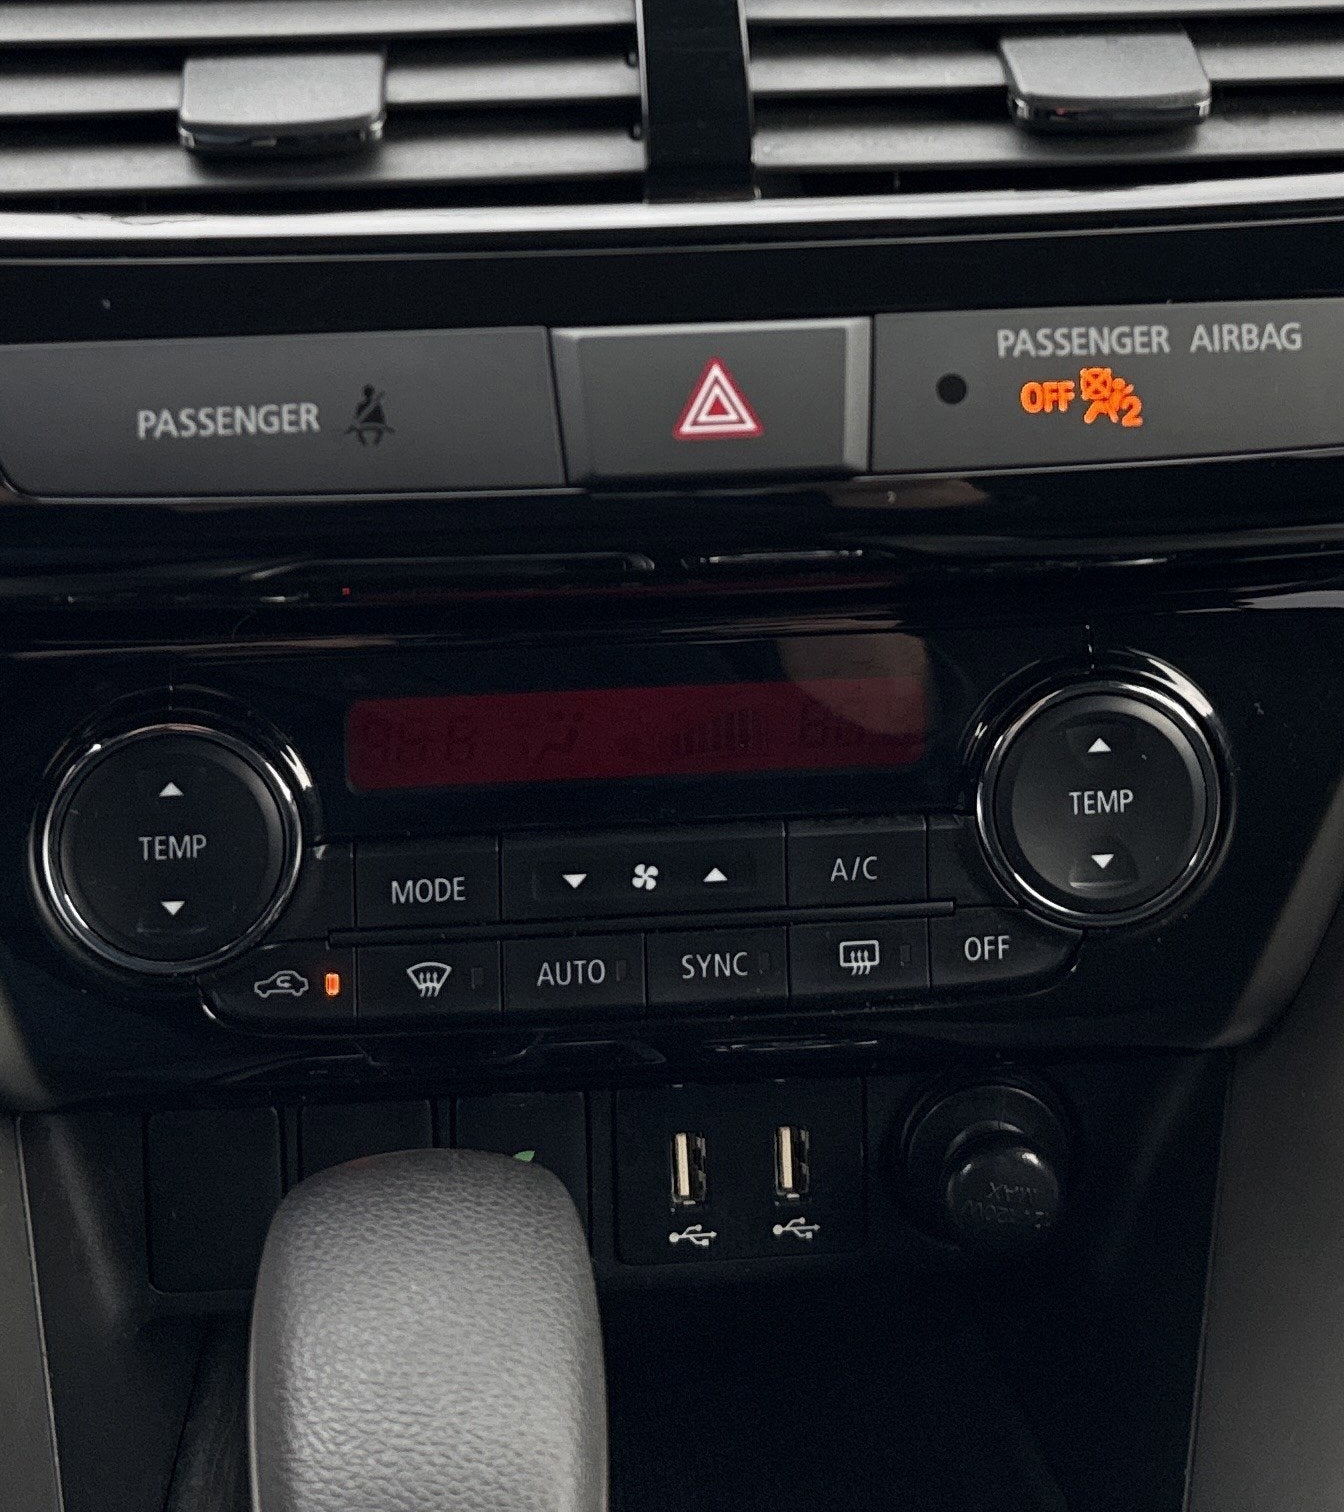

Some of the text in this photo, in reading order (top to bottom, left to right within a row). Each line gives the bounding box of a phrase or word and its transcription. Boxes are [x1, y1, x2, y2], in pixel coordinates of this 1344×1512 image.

[997, 321, 1303, 358] PASSENGER AIRBAG
[1020, 380, 1076, 414] OFF
[137, 402, 320, 439] PASSENGER
[1068, 789, 1134, 816] TEMP
[138, 834, 207, 861] TEMP
[830, 855, 878, 882] A/C
[391, 876, 466, 904] MODE
[964, 935, 1010, 962] OFF
[536, 959, 606, 987] AUTO
[681, 951, 748, 979] SYNC
